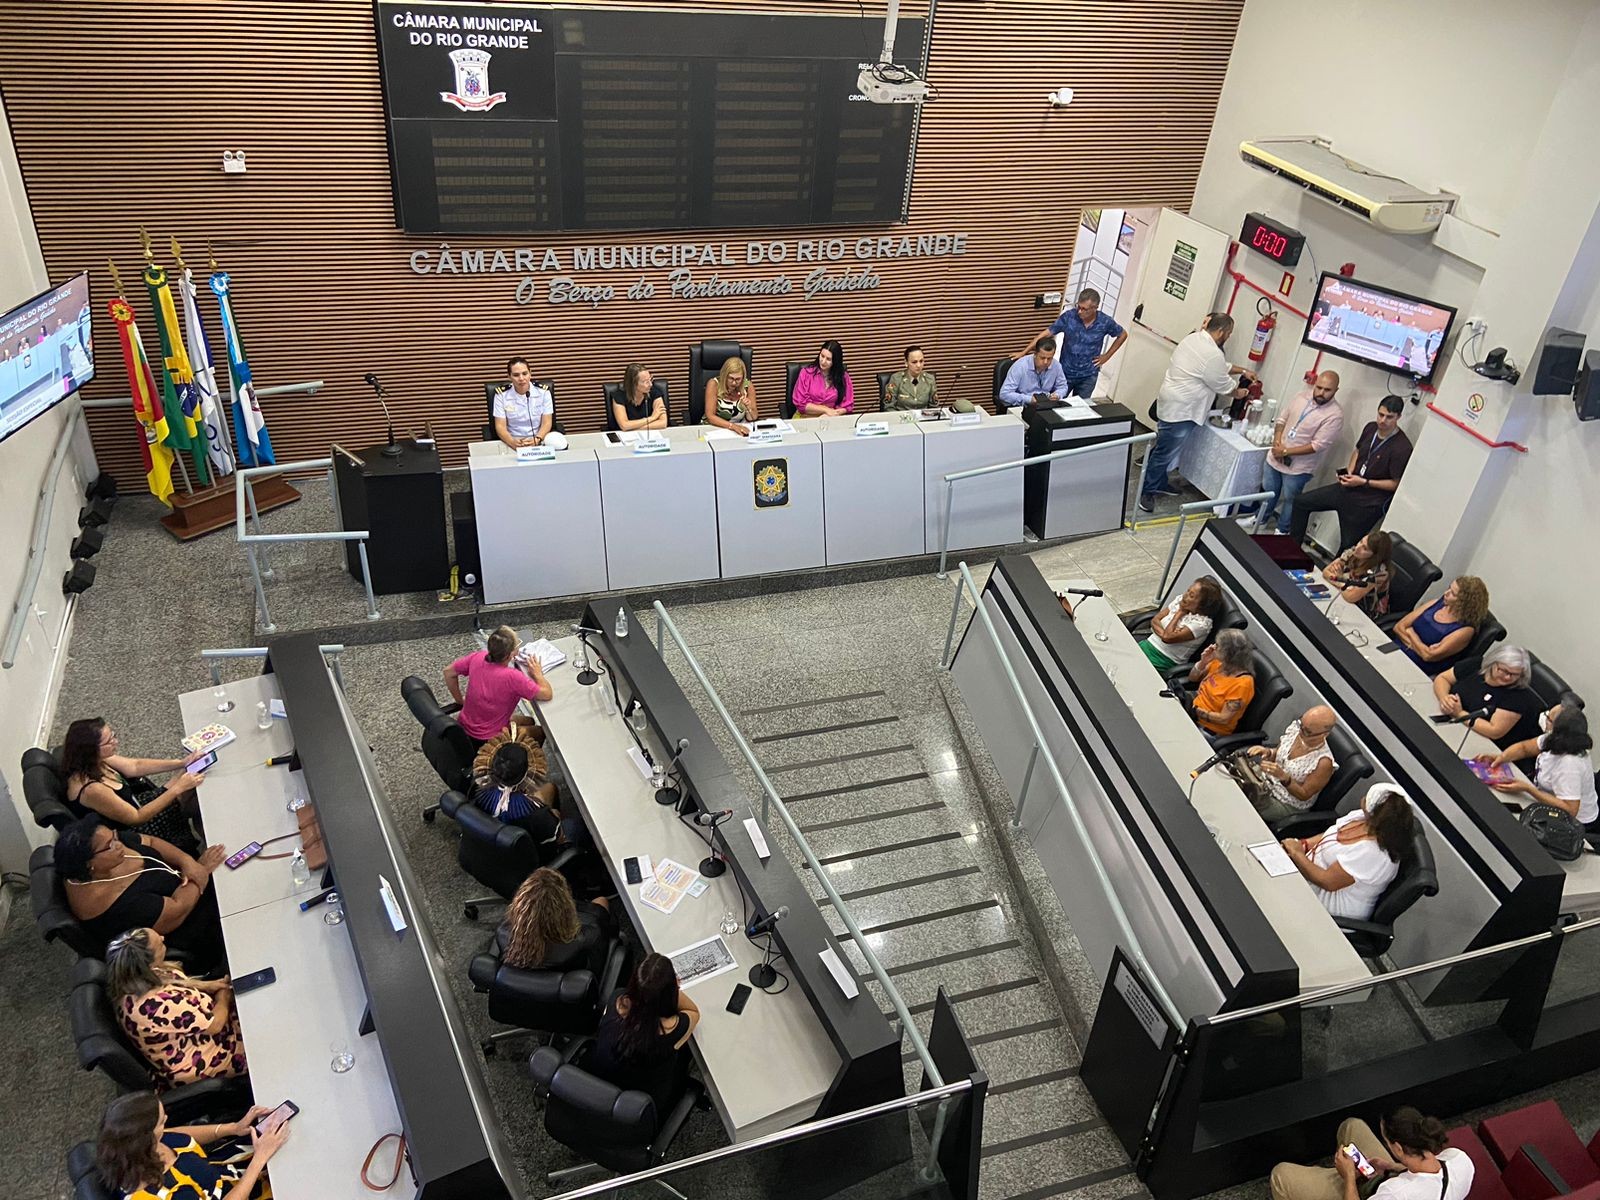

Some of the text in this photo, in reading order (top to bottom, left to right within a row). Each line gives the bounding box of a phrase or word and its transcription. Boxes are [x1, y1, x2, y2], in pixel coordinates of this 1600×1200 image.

[393, 11, 543, 33] CÂMARA MUNICIPAL
[410, 32, 529, 49] DO RIO GRANDE
[410, 233, 968, 274] CÂMARA MUNICIPAL DO RIO GRANDE
[1252, 226, 1287, 258] 0:00
[514, 264, 881, 309] O Berço do Parlamento Gaúcho
[0, 314, 27, 334] UNICIPAL
[48, 287, 72, 306] GRANDE
